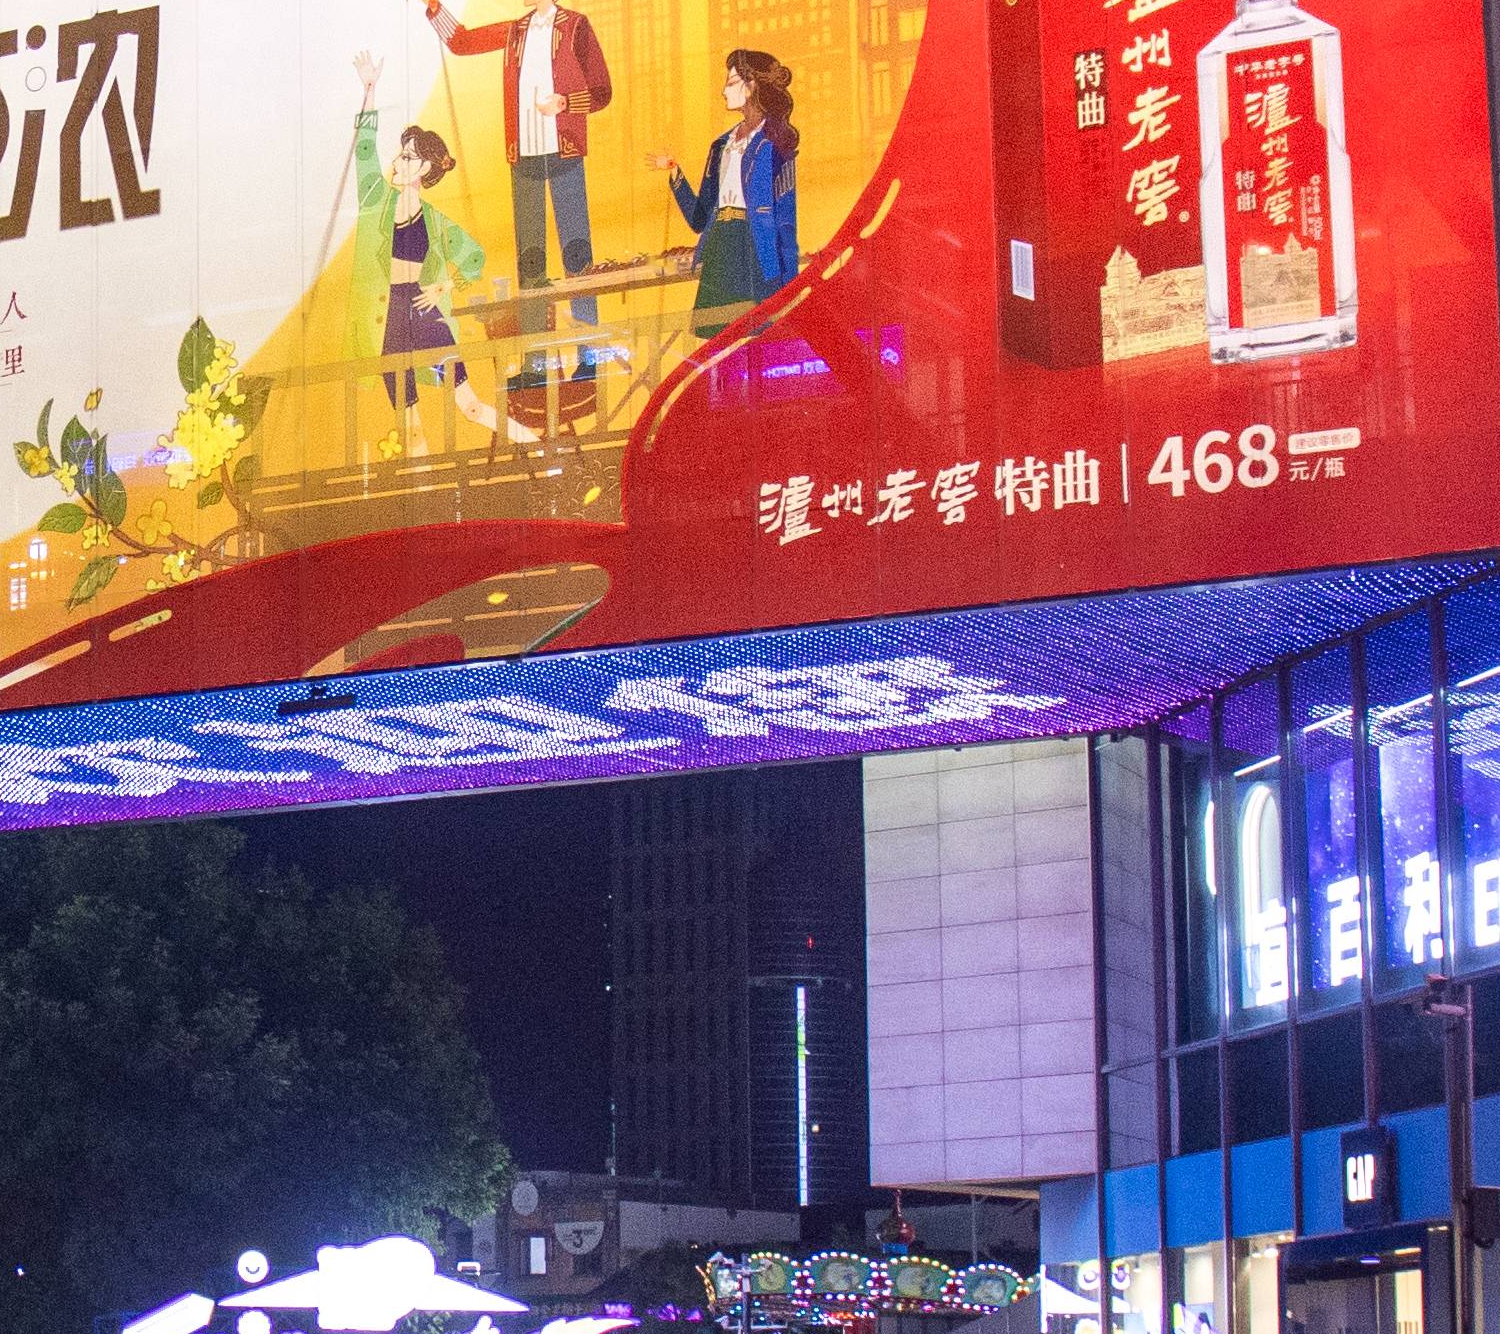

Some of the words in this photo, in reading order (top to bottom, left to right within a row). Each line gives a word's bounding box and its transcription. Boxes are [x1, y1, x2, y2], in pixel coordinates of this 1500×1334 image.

[1073, 52, 1107, 130] 特曲
[1243, 82, 1302, 226] 泸州老窖
[1147, 423, 1280, 498] 468
[1288, 456, 1346, 483] 元/瓶
